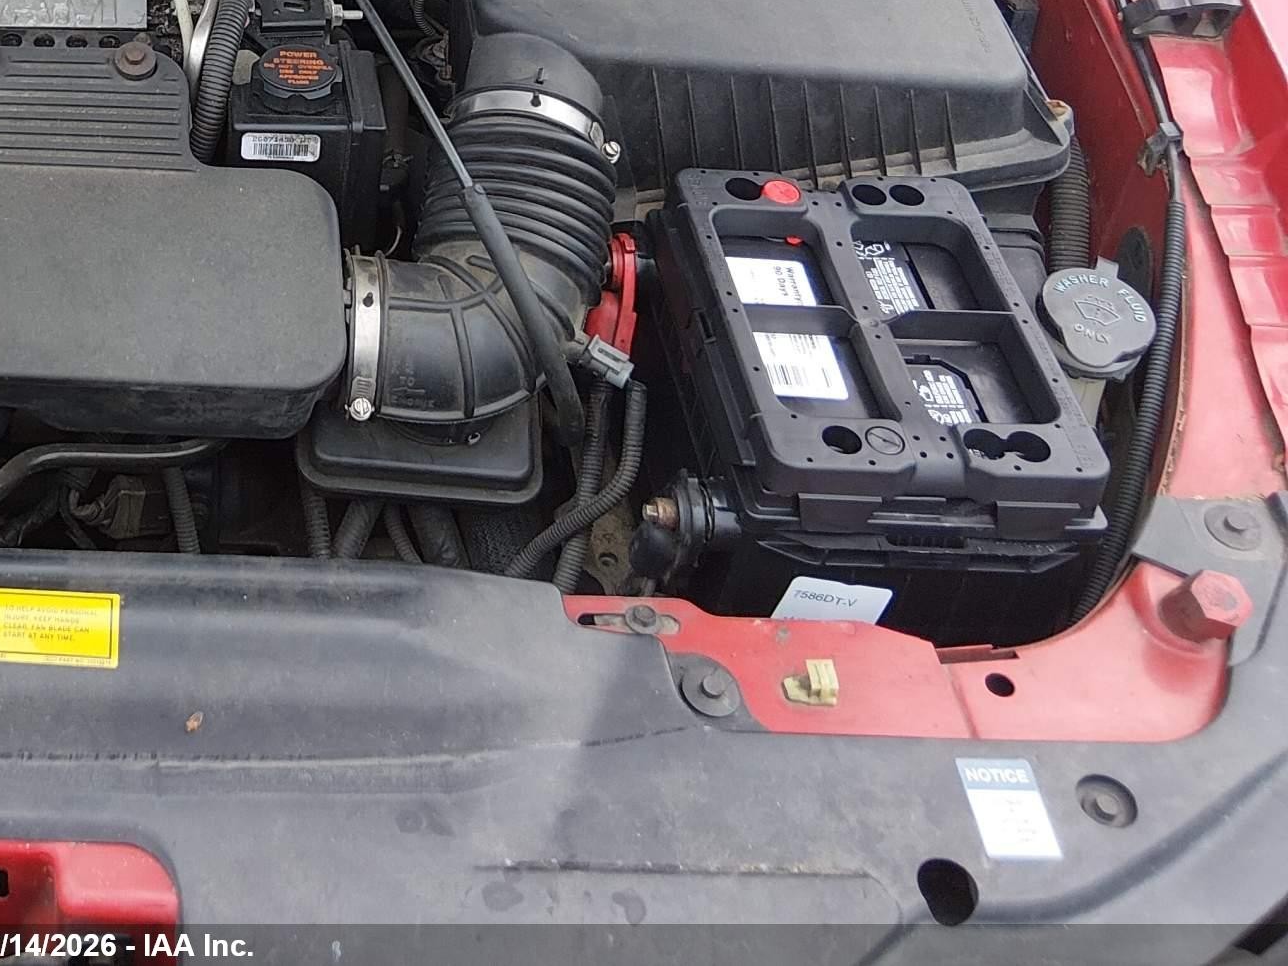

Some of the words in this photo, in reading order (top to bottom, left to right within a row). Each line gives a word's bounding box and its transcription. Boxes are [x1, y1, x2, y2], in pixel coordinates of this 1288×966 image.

[273, 57, 324, 65] STEERING
[279, 50, 317, 58] POWER
[1053, 274, 1109, 294] WASHER
[1117, 288, 1148, 323] FLUID
[1073, 322, 1109, 345] ONLY
[964, 767, 1030, 783] NOTICE
